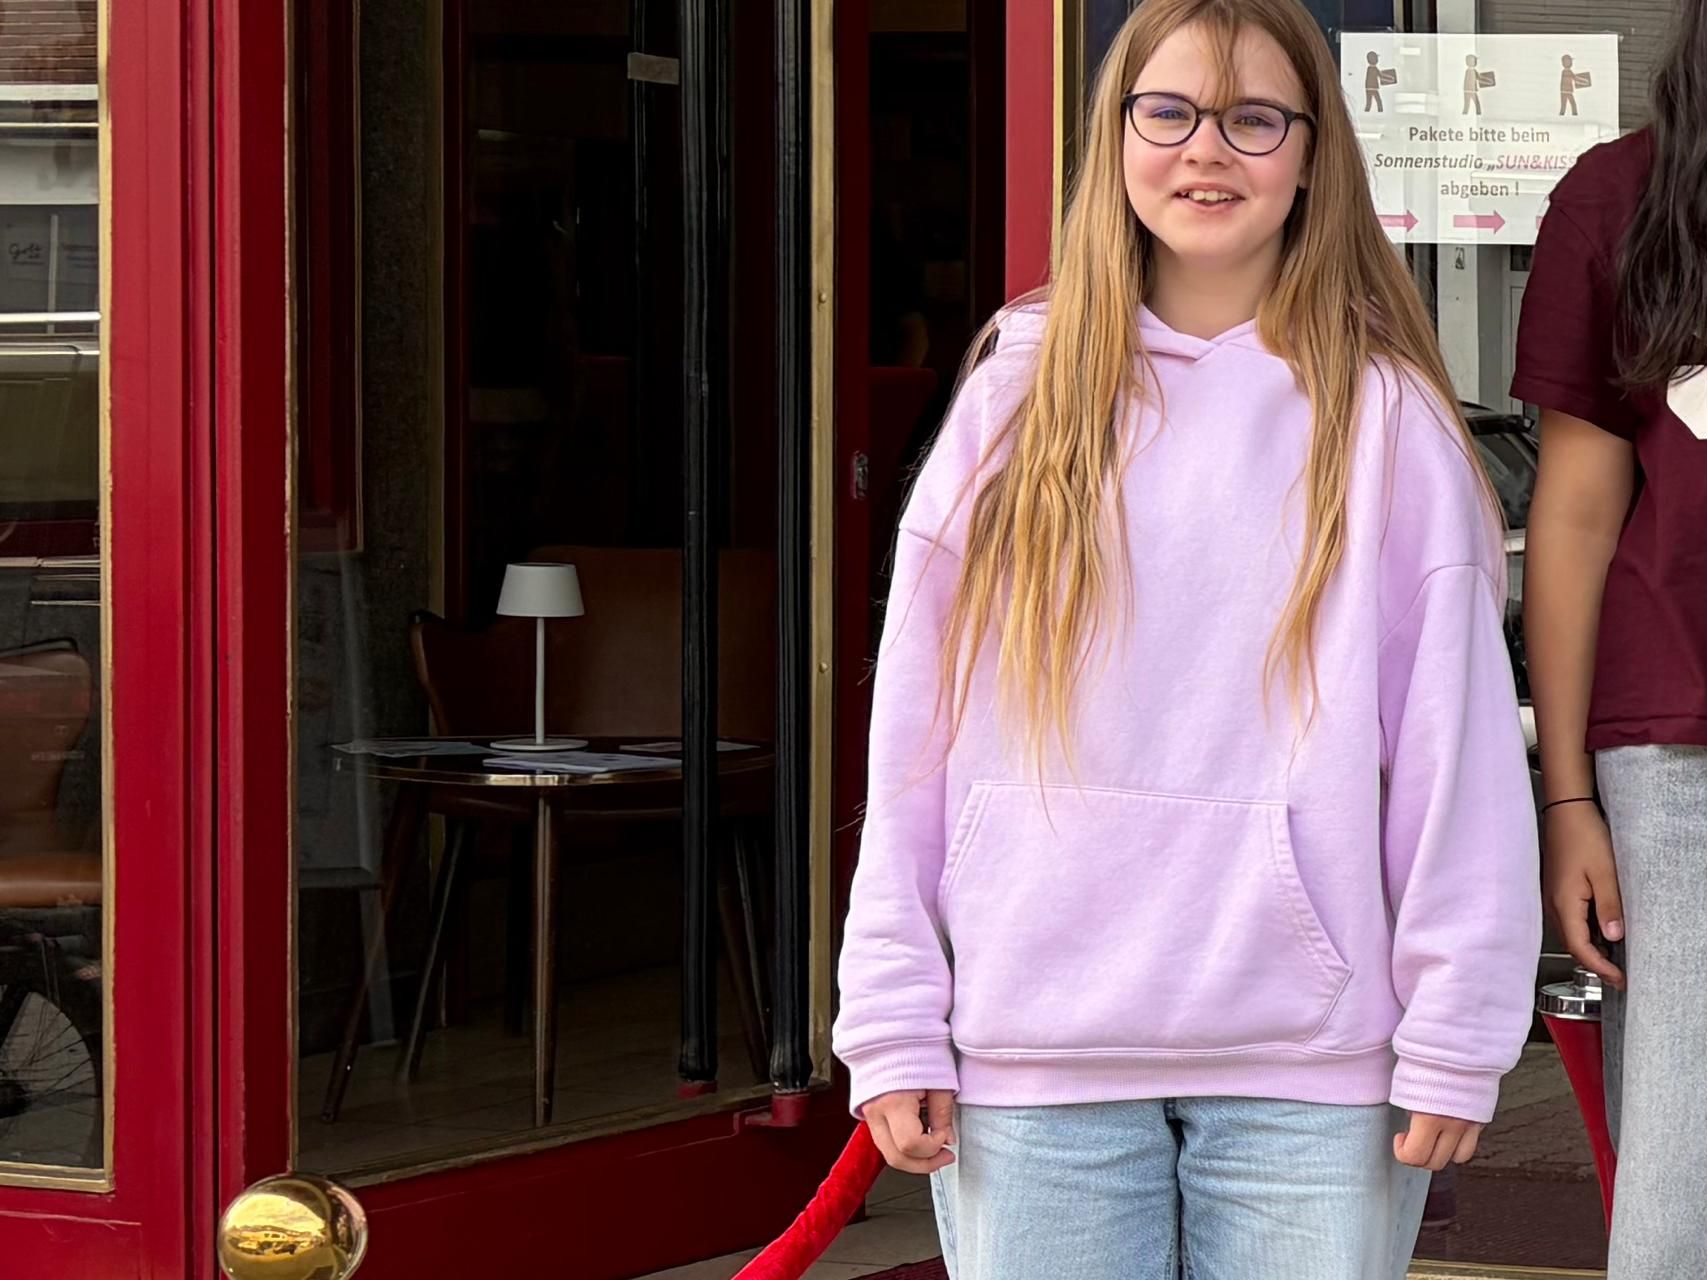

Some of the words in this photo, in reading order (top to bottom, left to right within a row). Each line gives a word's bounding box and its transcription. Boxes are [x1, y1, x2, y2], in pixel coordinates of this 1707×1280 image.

[1408, 126, 1464, 143] Pakete
[1468, 127, 1507, 143] bitte
[1511, 127, 1551, 144] beim
[1374, 153, 1483, 170] Sonnenstudio
[1440, 180, 1510, 198] abgeben
[1515, 181, 1520, 196] !
